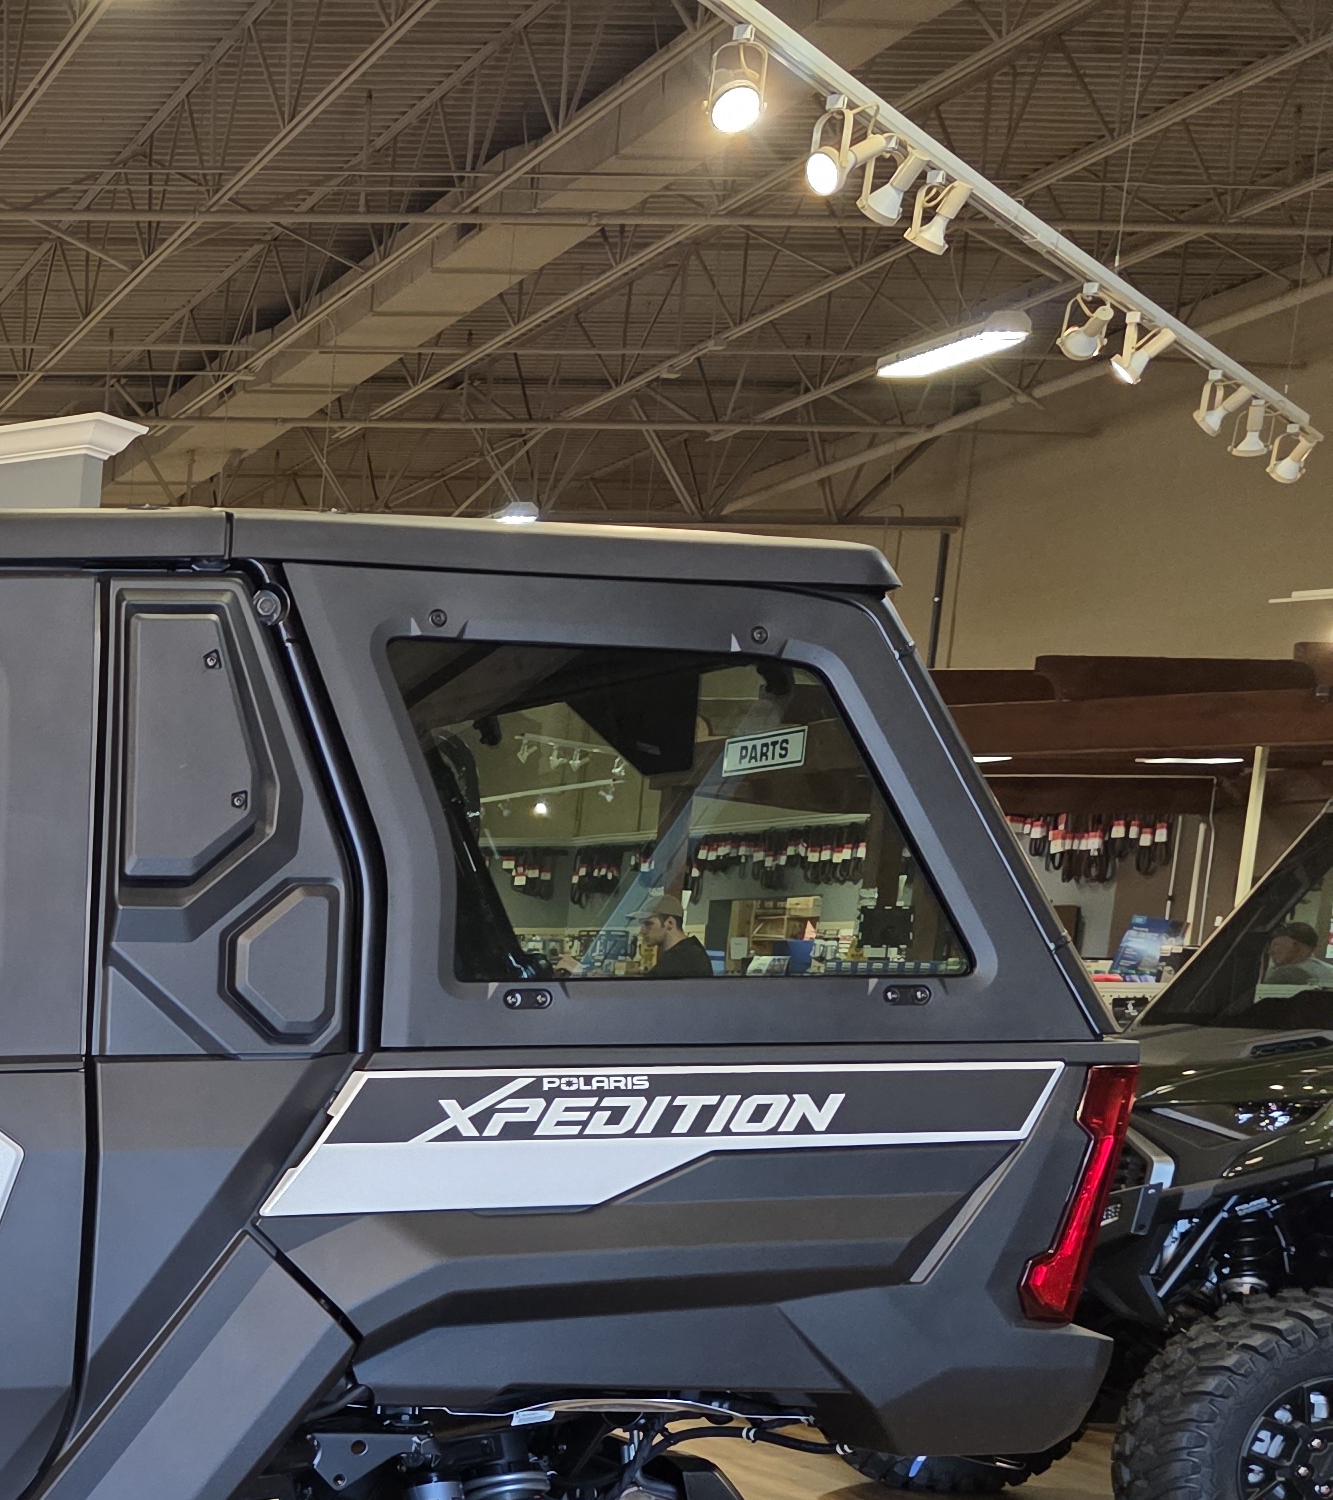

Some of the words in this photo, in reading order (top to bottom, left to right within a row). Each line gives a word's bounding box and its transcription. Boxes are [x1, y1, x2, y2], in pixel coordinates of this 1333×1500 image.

[738, 738, 790, 765] PARTS
[542, 1075, 650, 1091] POLARIS
[408, 1077, 846, 1143] XPEDITION
